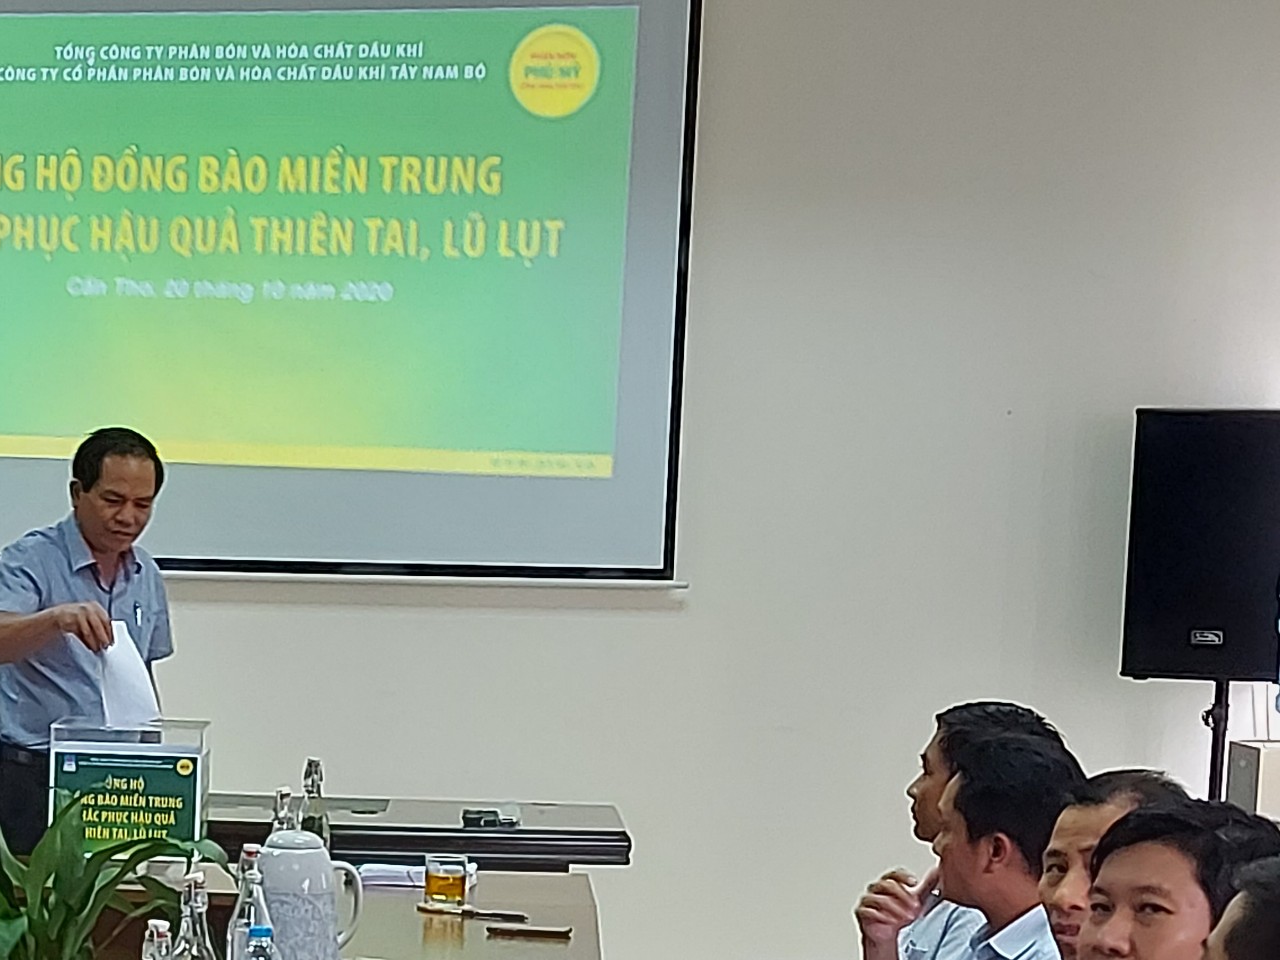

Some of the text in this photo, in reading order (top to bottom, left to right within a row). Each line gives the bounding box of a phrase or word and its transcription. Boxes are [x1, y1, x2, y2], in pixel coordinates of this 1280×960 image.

[145, 46, 163, 60] TY
[251, 43, 271, 59] VÀ
[396, 41, 424, 58] KHÍ
[40, 67, 59, 81] TY
[215, 66, 235, 81] VÀ
[358, 63, 385, 80] KHÍ
[422, 66, 459, 80] NAM
[35, 148, 83, 202] HỘ
[91, 145, 189, 193] ĐỒNG
[198, 147, 268, 193] BÀO
[277, 144, 369, 195] MIỀN
[377, 155, 503, 196] TRUNG
[250, 210, 355, 258] THIÊN
[363, 216, 430, 262] TAI,
[442, 211, 487, 259] LŨ
[496, 218, 565, 268] LỤT
[80, 793, 95, 806] NG
[148, 796, 183, 809] TRUNG
[85, 825, 110, 840] HIÊN
